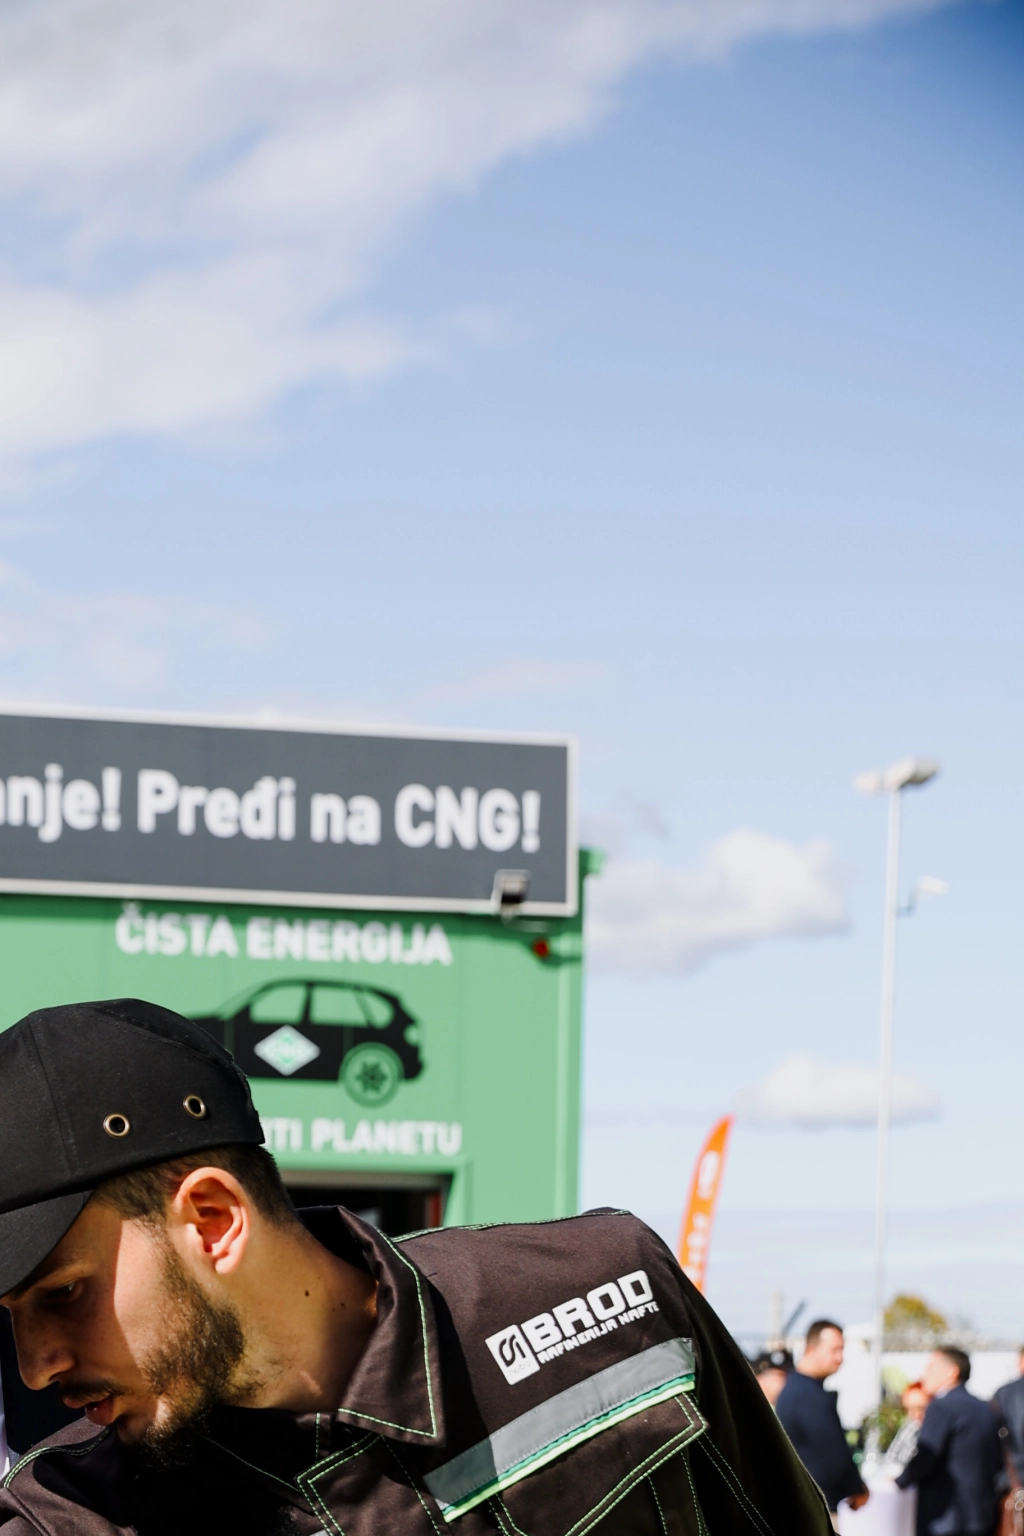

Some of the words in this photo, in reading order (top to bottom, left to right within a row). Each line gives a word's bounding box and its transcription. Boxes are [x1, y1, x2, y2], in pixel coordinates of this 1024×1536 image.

[310, 792, 381, 847] na
[394, 783, 542, 853] CNG!
[116, 901, 239, 959] ČISTA
[246, 911, 453, 967] ENERGIJA
[310, 1117, 463, 1157] PLANETU
[521, 1269, 653, 1352] BROD
[536, 1318, 618, 1365] RAFINERIJA
[618, 1301, 660, 1326] NAFTE
